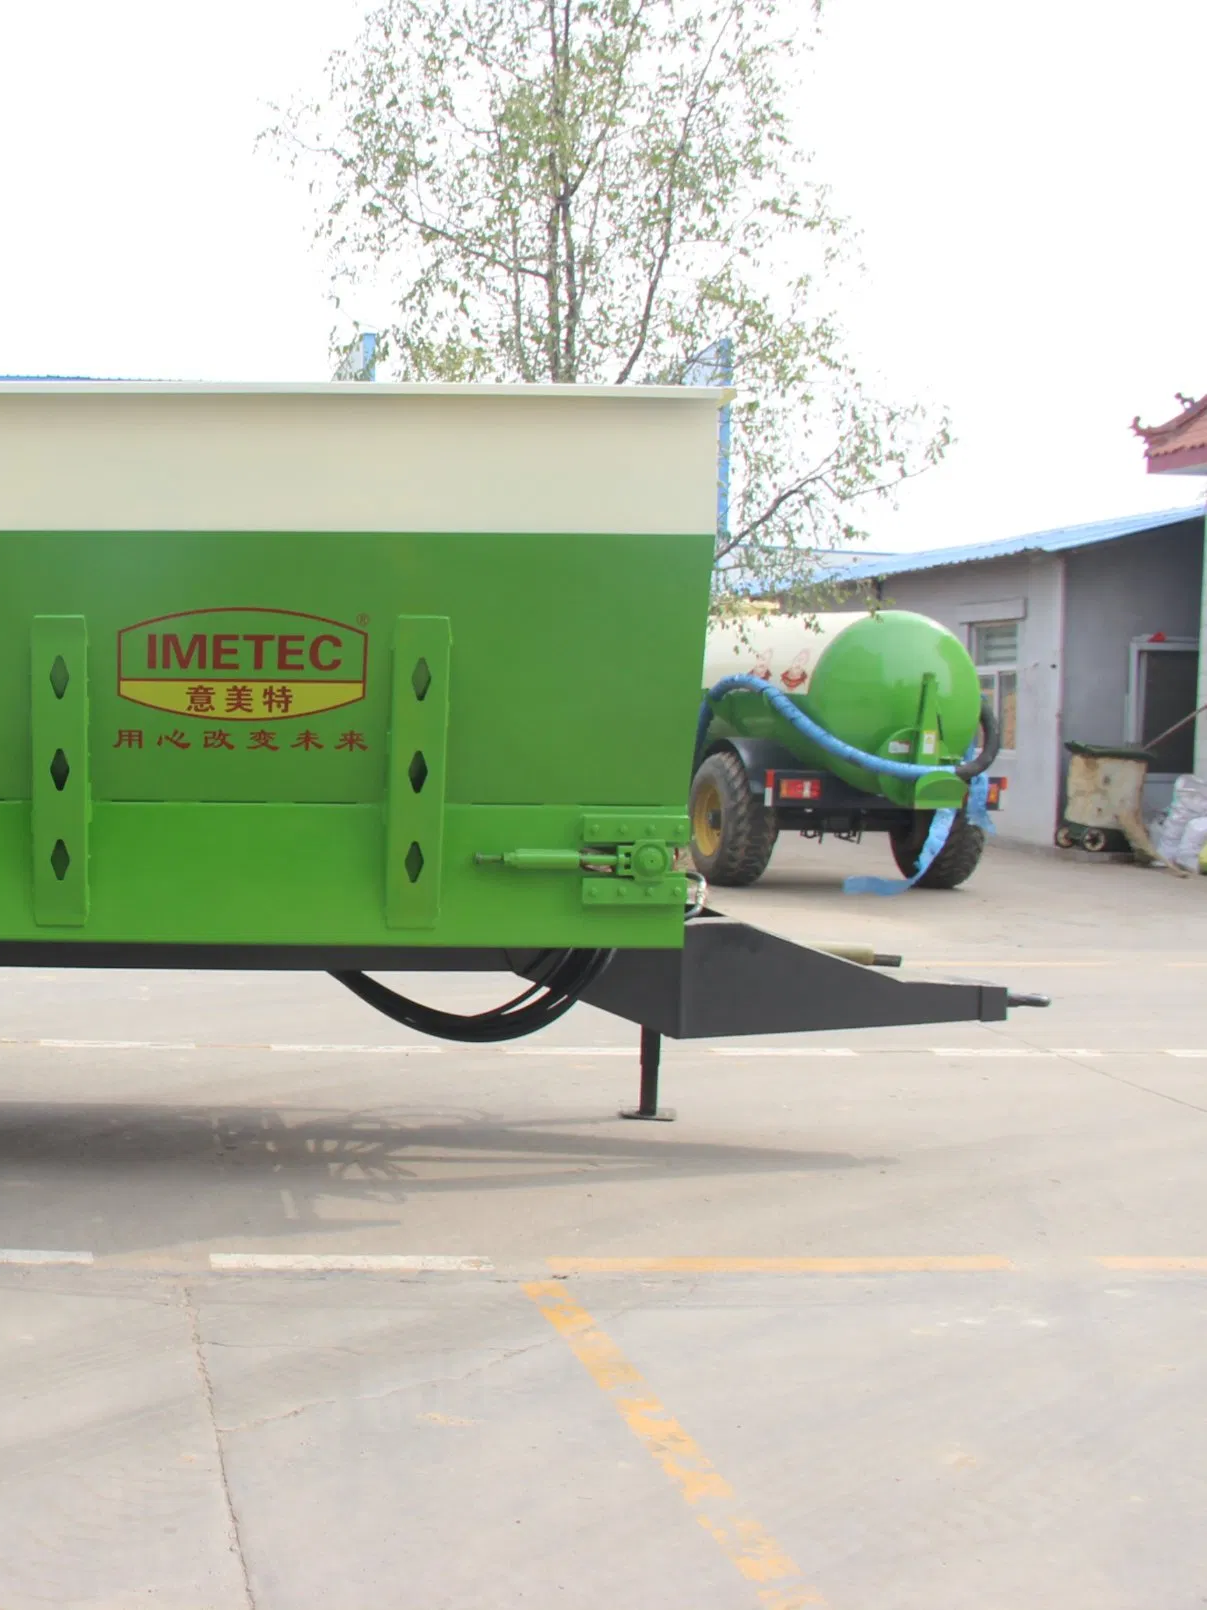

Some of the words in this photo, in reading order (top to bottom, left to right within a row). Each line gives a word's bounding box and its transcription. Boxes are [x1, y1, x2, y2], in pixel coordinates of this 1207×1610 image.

[147, 633, 343, 672] IMETEC
[185, 685, 294, 713] 意美特
